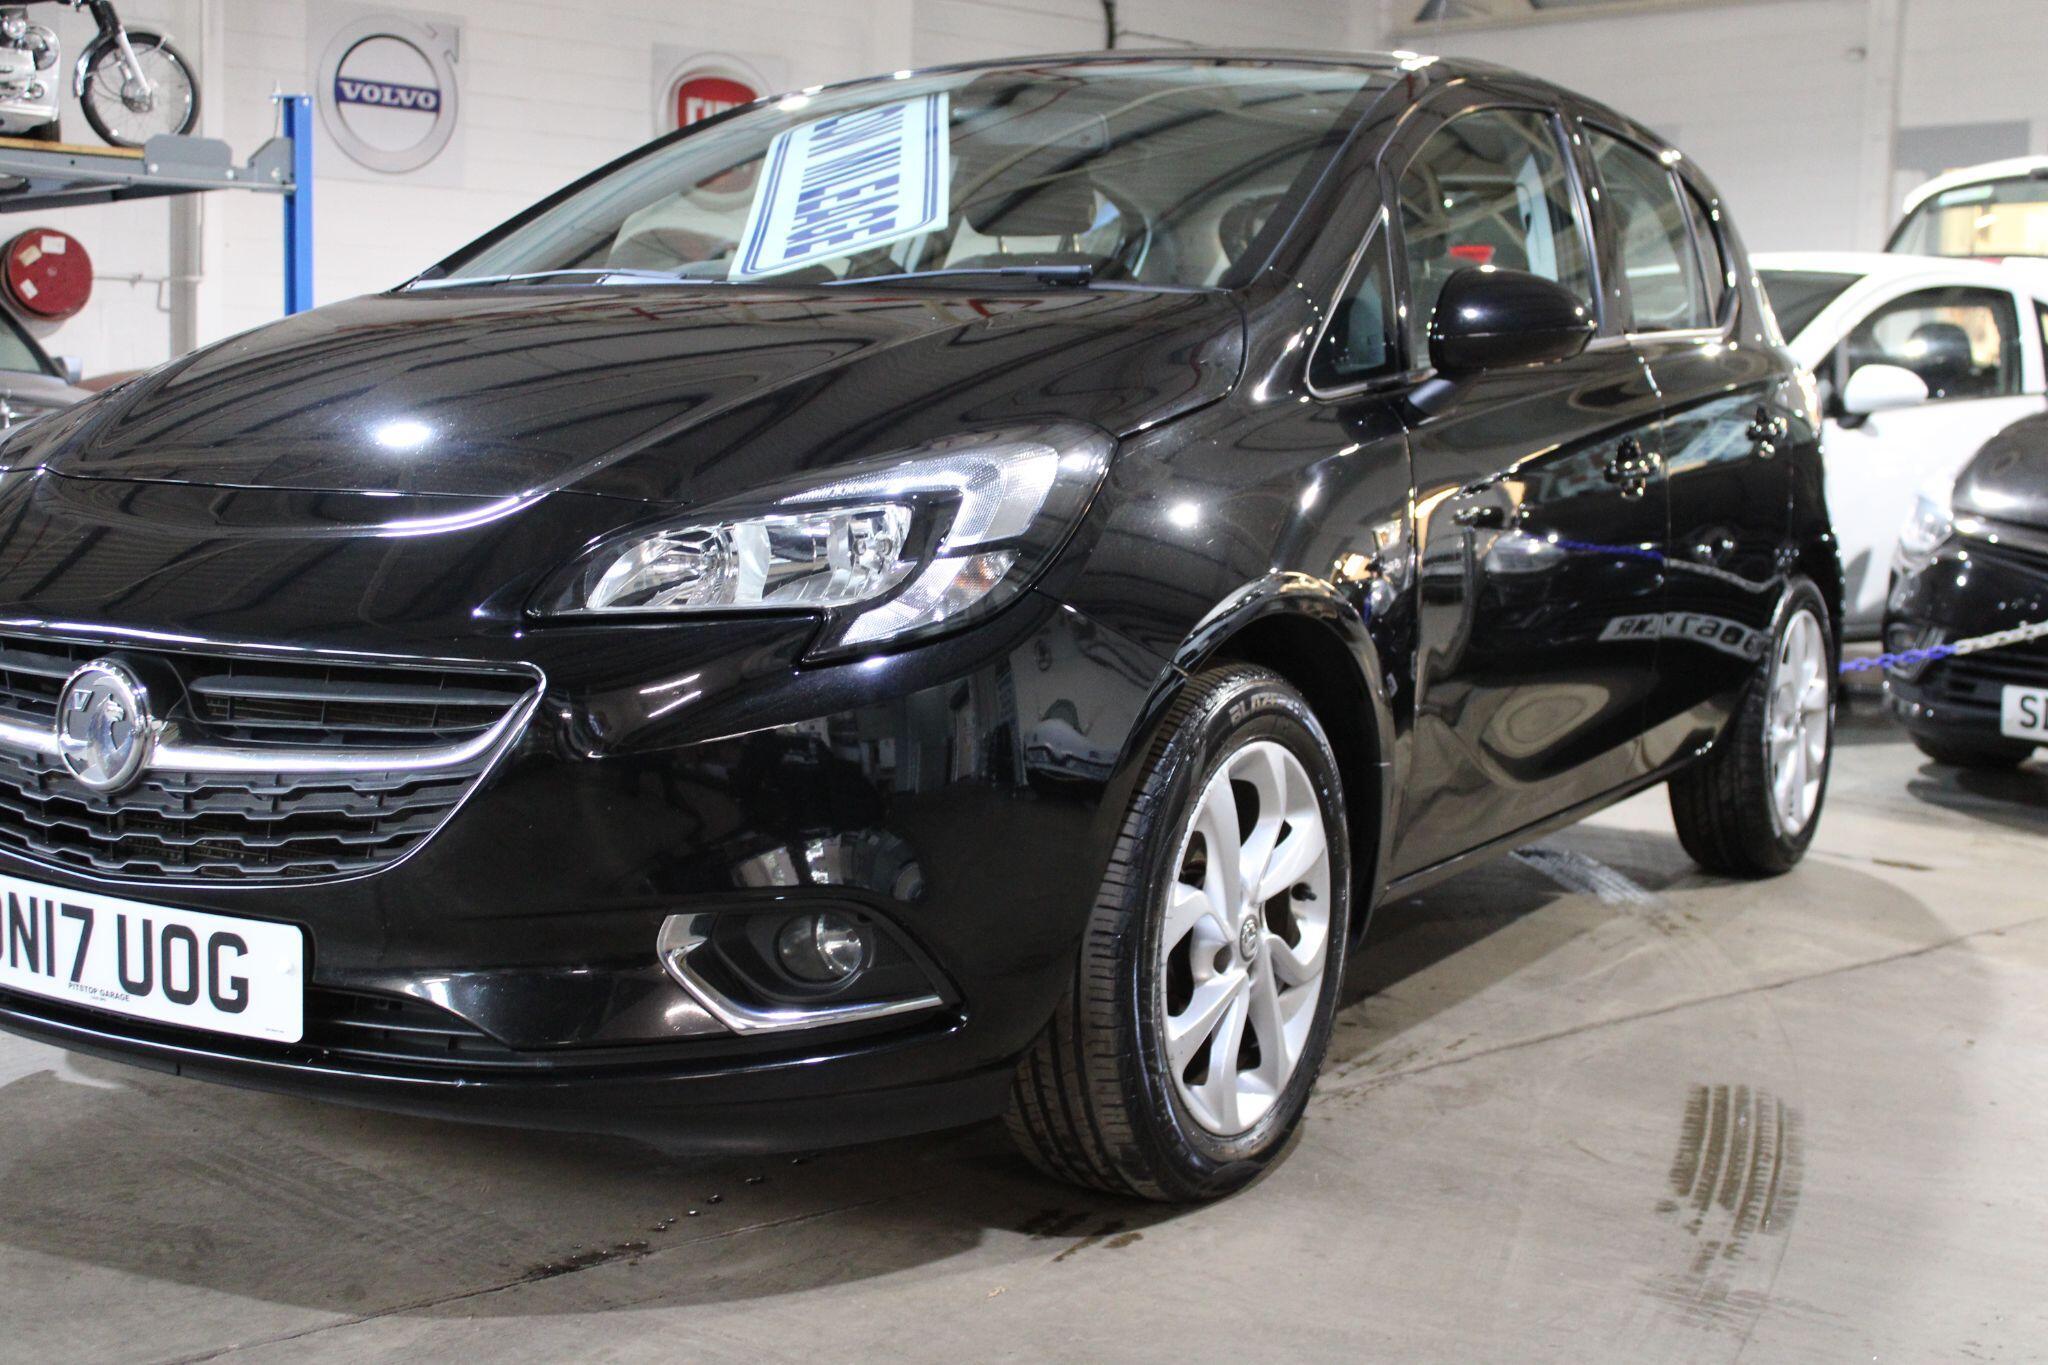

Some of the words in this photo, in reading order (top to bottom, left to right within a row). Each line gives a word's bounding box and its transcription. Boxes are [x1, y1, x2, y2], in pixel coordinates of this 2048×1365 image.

[340, 80, 437, 110] VOLVO
[808, 104, 906, 159] LOW
[783, 136, 902, 260] MILEAGE
[2019, 694, 2048, 730] S
[0, 891, 95, 983] N17
[117, 913, 249, 1014] UOG
[99, 989, 130, 1001] GARAGE
